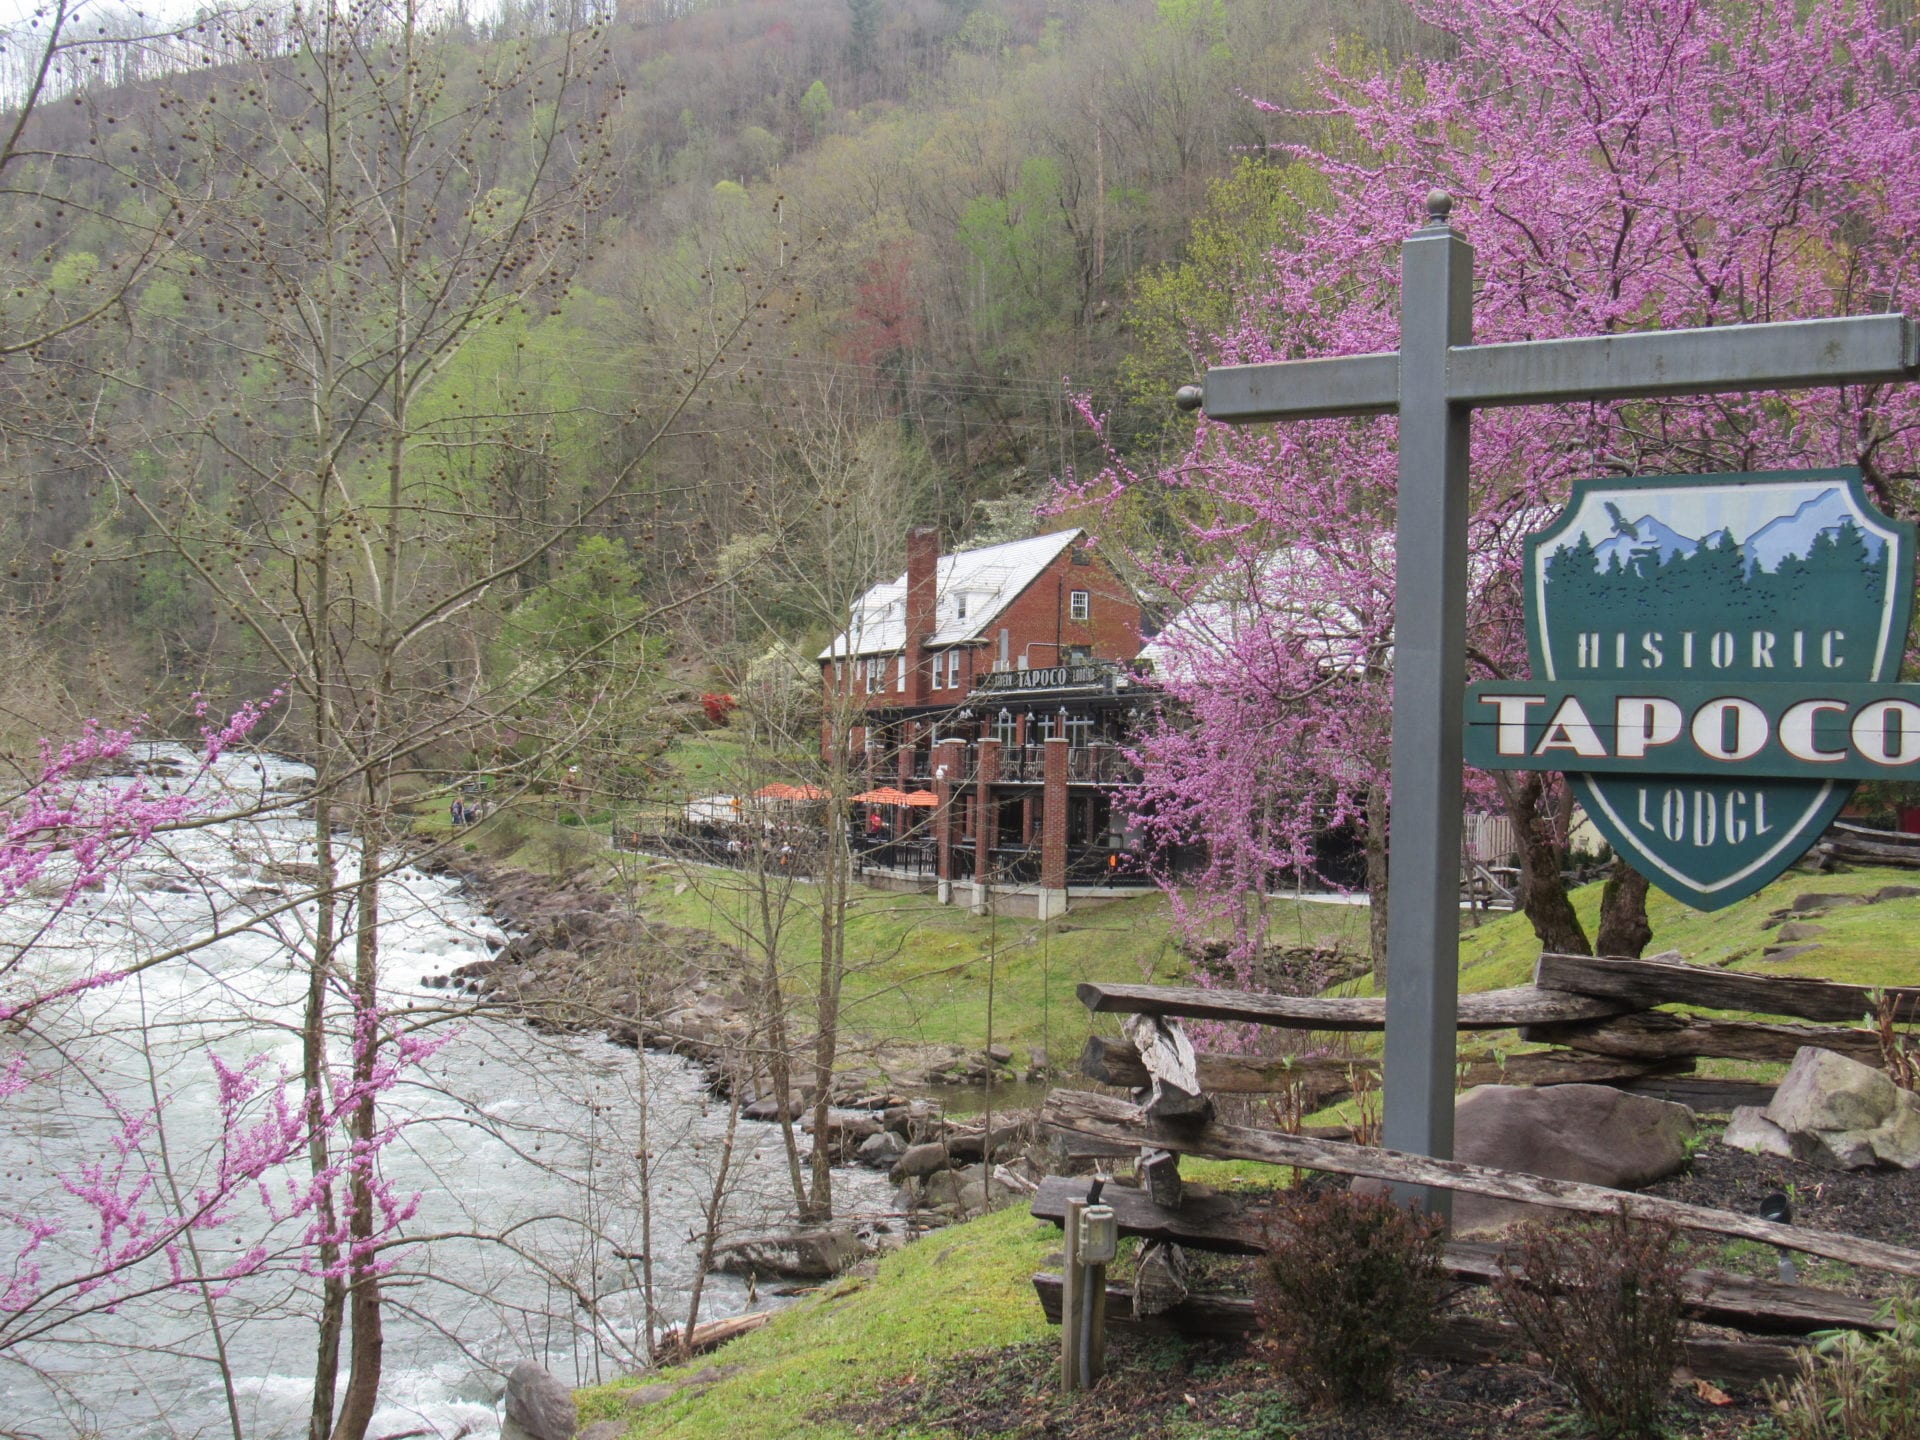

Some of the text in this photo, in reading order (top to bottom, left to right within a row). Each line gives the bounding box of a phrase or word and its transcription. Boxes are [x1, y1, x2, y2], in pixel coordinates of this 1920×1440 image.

[1578, 630, 1845, 668] HISTORIC
[1017, 668, 1067, 688] TAPOCO
[1478, 695, 1920, 766] TAPOCO
